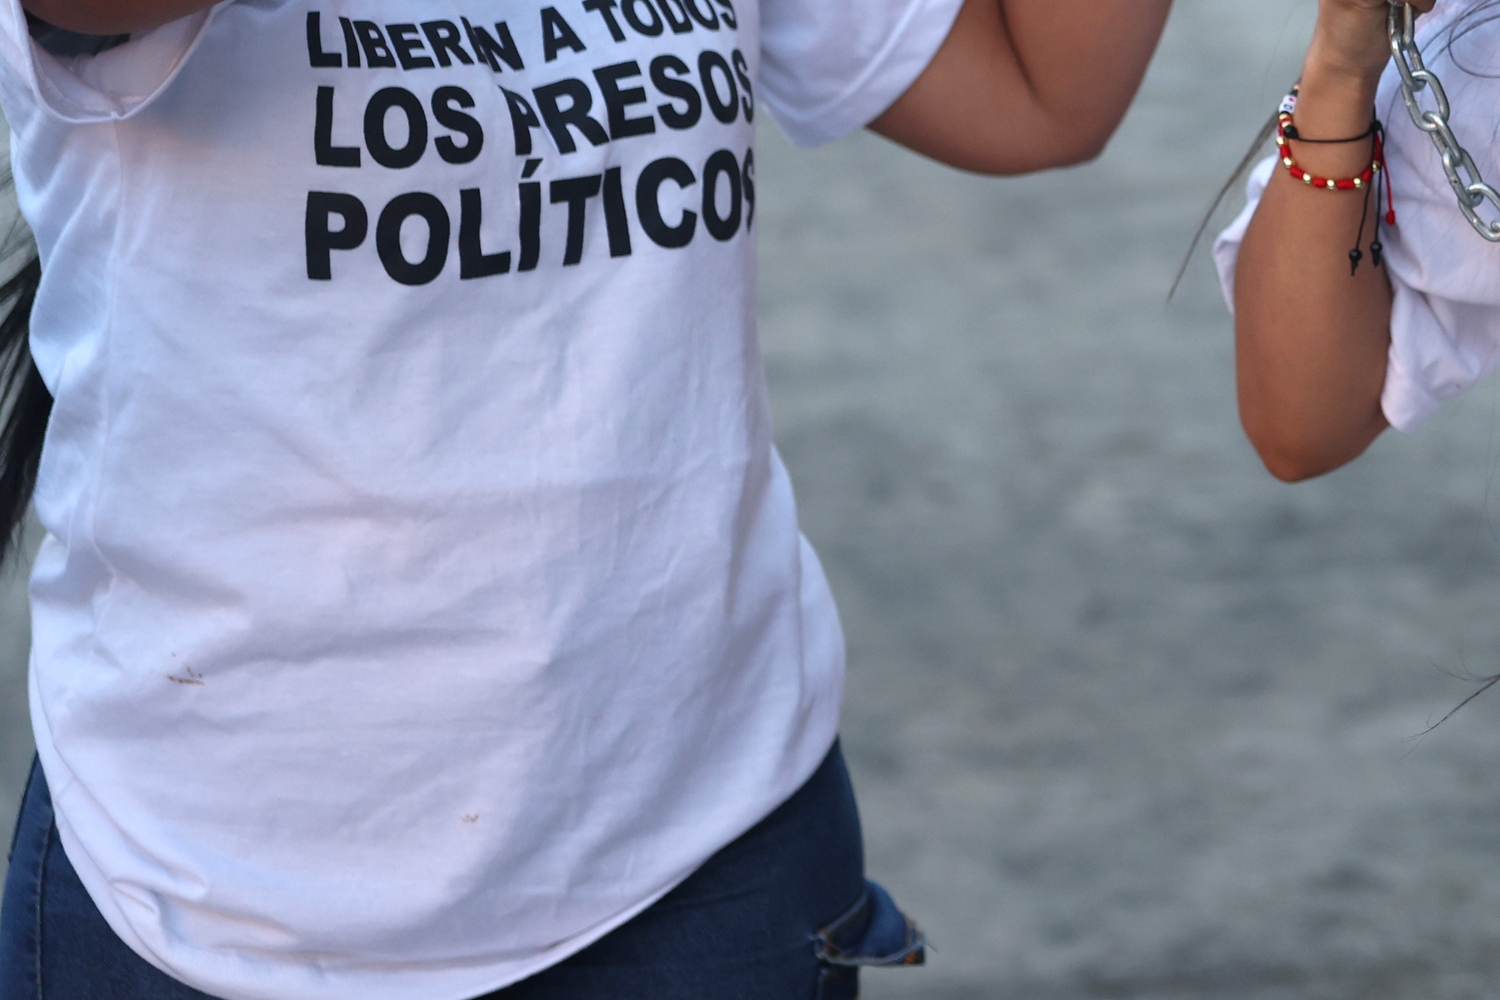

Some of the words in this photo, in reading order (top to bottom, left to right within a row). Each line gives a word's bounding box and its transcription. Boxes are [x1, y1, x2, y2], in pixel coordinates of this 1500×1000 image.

[539, 5, 587, 63] A
[313, 84, 485, 169] LOS
[496, 47, 754, 156] PRESOS
